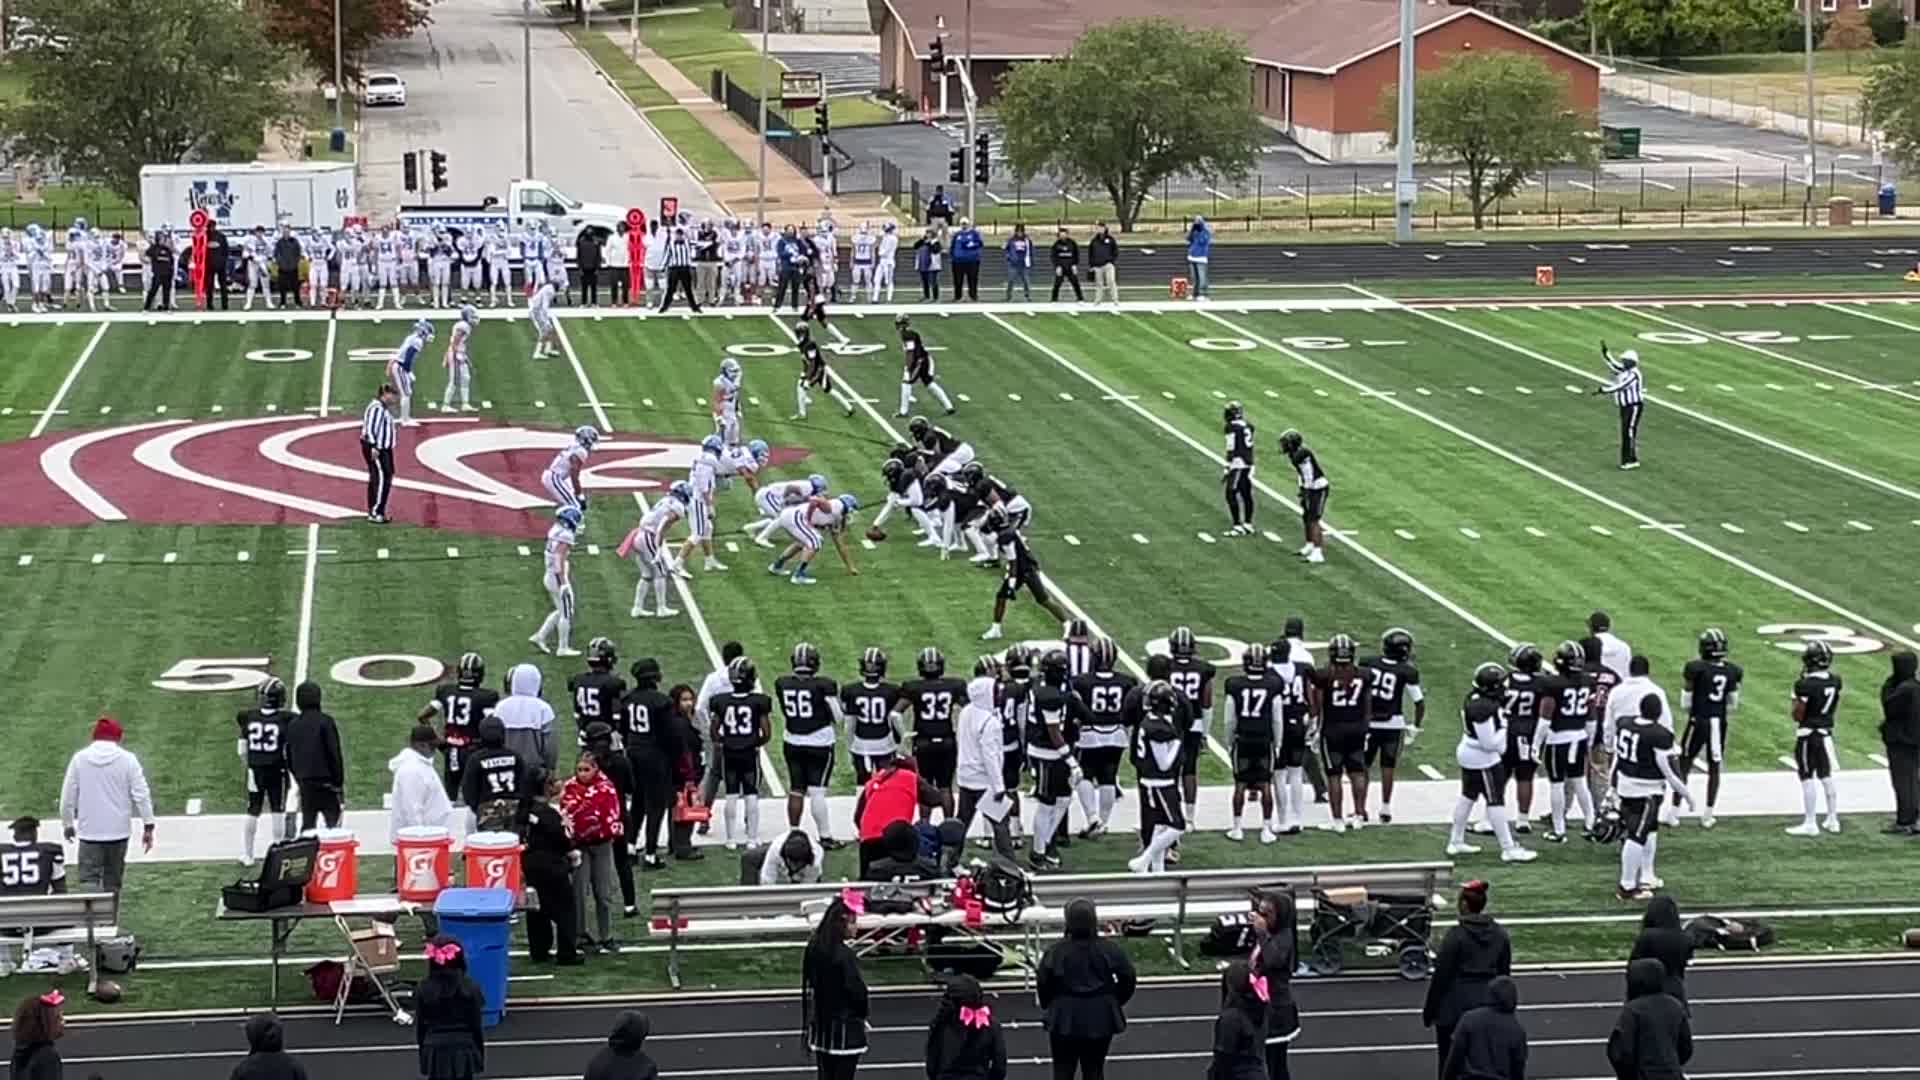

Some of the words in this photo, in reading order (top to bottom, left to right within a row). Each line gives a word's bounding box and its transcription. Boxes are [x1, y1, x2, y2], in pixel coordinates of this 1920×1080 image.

[575, 687, 600, 716] 45
[1091, 686, 1122, 713] 63
[1240, 688, 1268, 717] 17
[1331, 678, 1363, 707] 27
[1560, 687, 1590, 716] 32
[1709, 674, 1727, 702] 3
[1820, 687, 1836, 715] 7
[447, 695, 471, 725] 13
[783, 689, 813, 718] 56
[855, 696, 886, 724] 30
[921, 692, 951, 720] 33
[1503, 690, 1535, 716] 72
[627, 703, 650, 733] 19
[723, 706, 752, 735] 43
[247, 722, 280, 752] 23
[1616, 729, 1641, 763] 51
[486, 772, 516, 794] 17
[1, 851, 41, 886] 55
[319, 854, 337, 872] G
[408, 854, 430, 874] G
[487, 858, 506, 878] G
